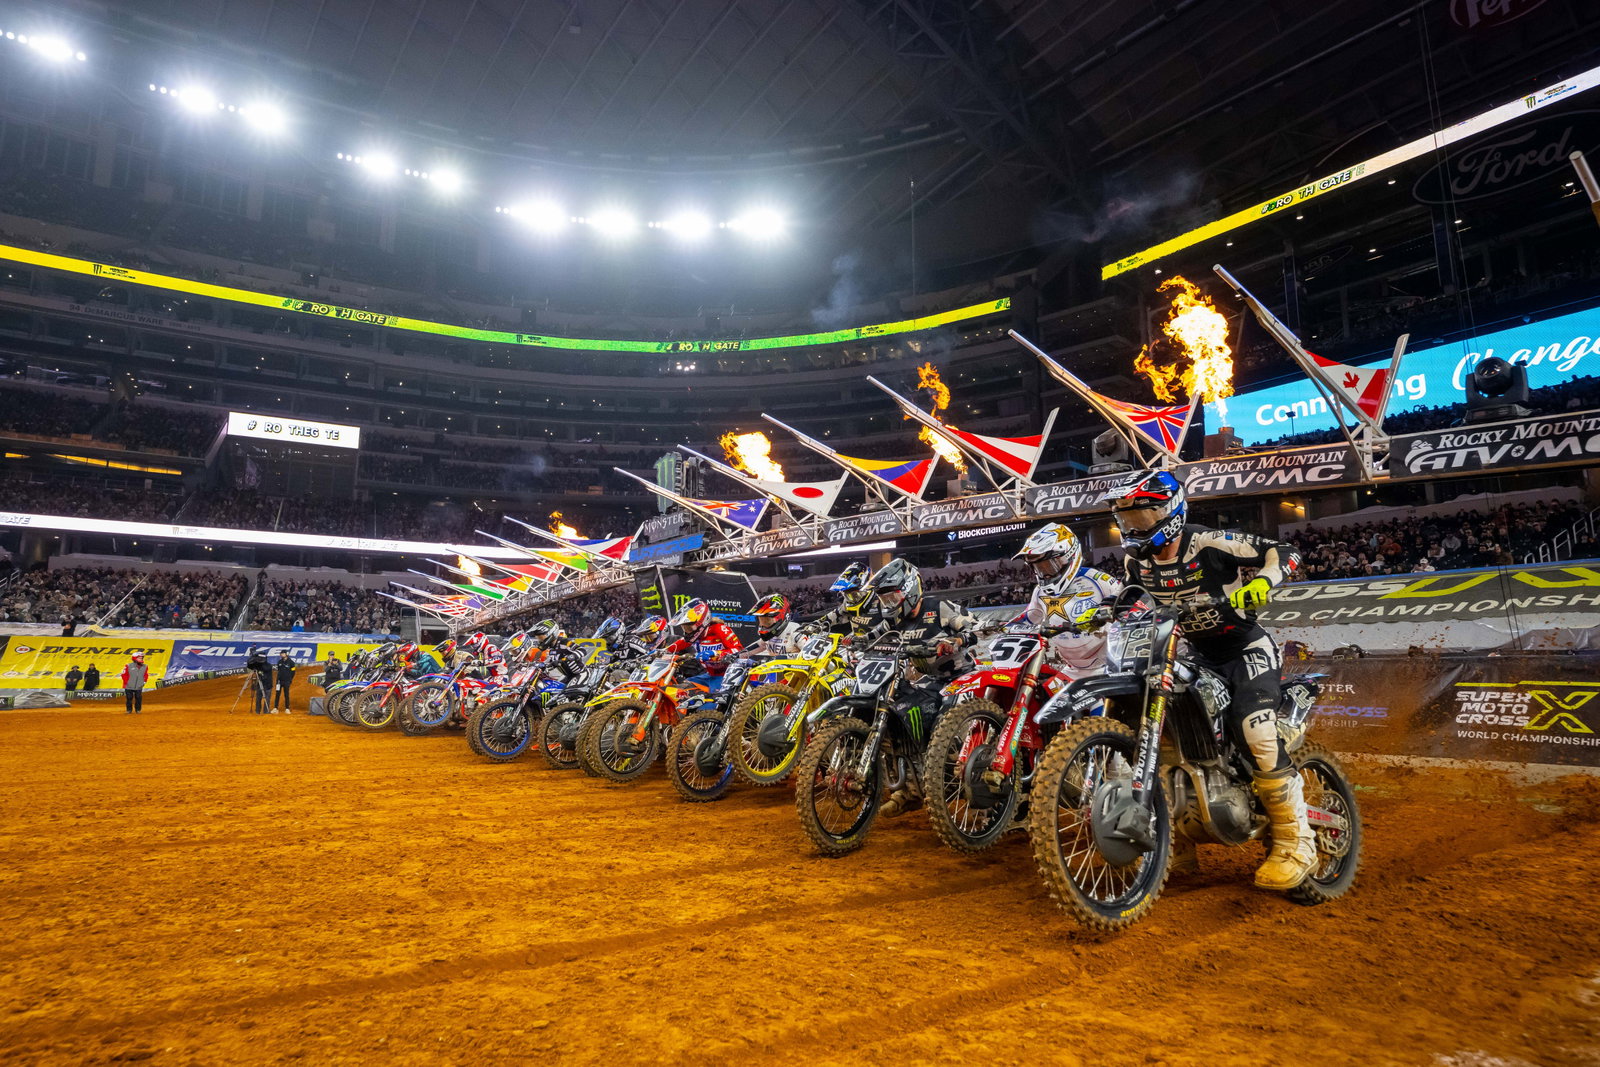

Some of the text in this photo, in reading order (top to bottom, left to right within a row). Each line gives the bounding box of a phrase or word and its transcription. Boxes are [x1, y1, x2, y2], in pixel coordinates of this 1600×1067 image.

[1452, 125, 1578, 197] Ford
[1319, 170, 1351, 191] GATE
[355, 310, 387, 325] GATE
[1436, 418, 1600, 450] ROCKY MOUNT
[1207, 450, 1347, 475] ROCKY MOUNTAIN
[1051, 478, 1124, 497] ROCKY MOUN
[931, 495, 1005, 514] ROCKY MOUNTAIN
[644, 512, 685, 534] MONSTER
[838, 513, 897, 529] ROCKY MOUNTAIN
[760, 529, 805, 544] ROCKY MOUNTAI
[958, 522, 1026, 540] Blockchain.com
[1268, 578, 1418, 602] OSS
[706, 599, 742, 608] MONSTER
[1308, 593, 1600, 622] CHAMPIONSH
[40, 645, 165, 656] DUNLOP
[181, 644, 313, 657] FALKEN
[802, 638, 831, 657] 45
[991, 637, 1041, 664] 51
[650, 662, 669, 678] 7
[858, 661, 893, 685] 46
[1287, 684, 1317, 709] 12
[1318, 683, 1356, 695] STER
[1455, 690, 1533, 703] SUPER
[1460, 702, 1529, 715] MOTO
[1249, 711, 1271, 729] FLY
[1455, 714, 1531, 727] CROSS
[1457, 729, 1499, 740] WORLD
[1133, 728, 1150, 780] DUNLO
